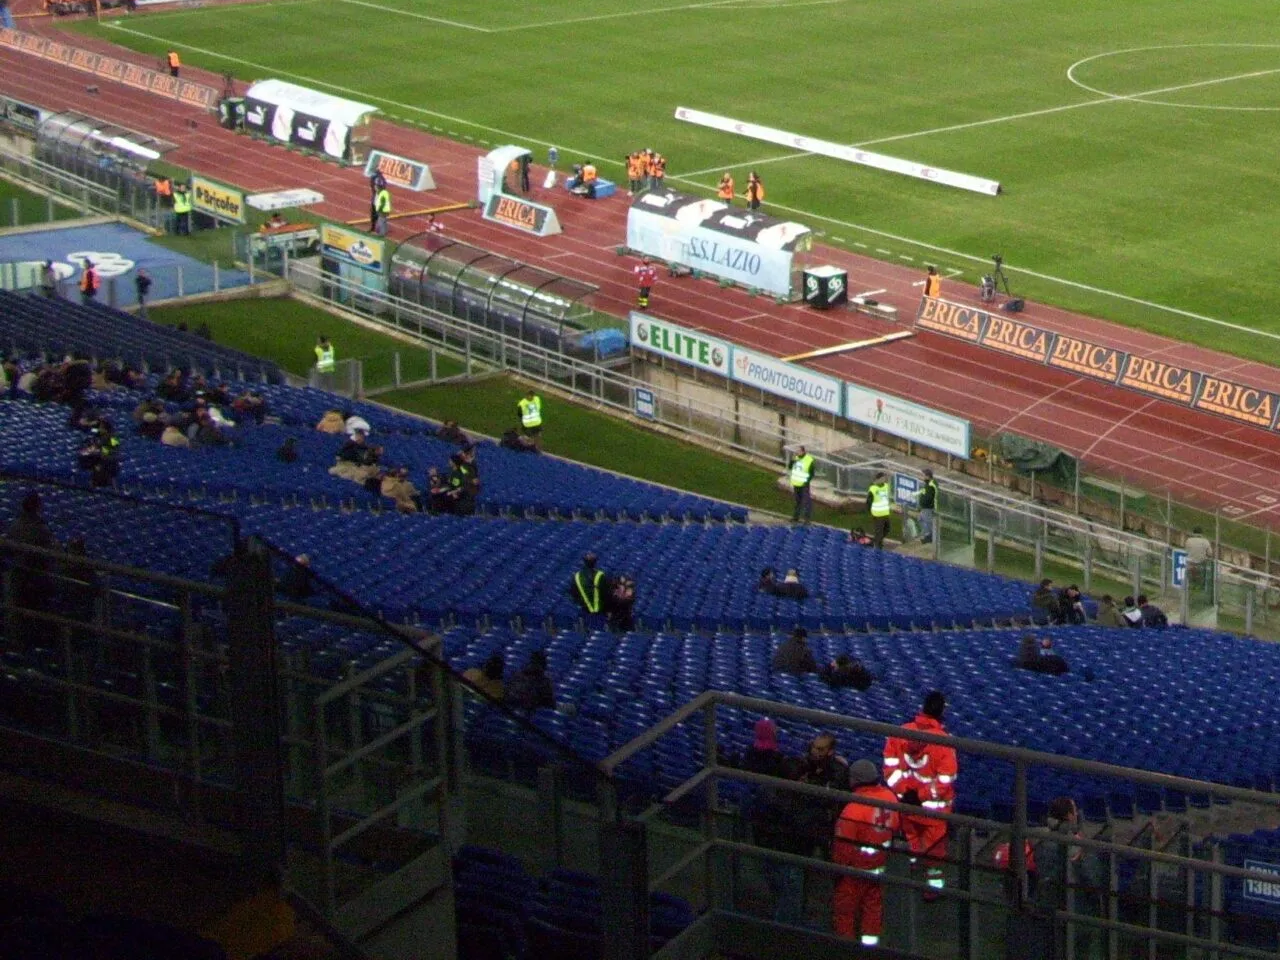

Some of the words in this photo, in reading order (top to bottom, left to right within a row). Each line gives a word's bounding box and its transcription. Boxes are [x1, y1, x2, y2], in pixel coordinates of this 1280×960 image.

[378, 155, 413, 180] ERICA
[496, 197, 536, 227] ERICA
[923, 298, 980, 335] ERICA
[986, 315, 1046, 352] ERICA
[650, 324, 709, 365] ELITE
[1051, 334, 1118, 373] ERICA
[748, 362, 835, 404] PRONTOBOLLO.IT
[1122, 355, 1192, 395] ERICA
[1200, 378, 1272, 419] ERICA
